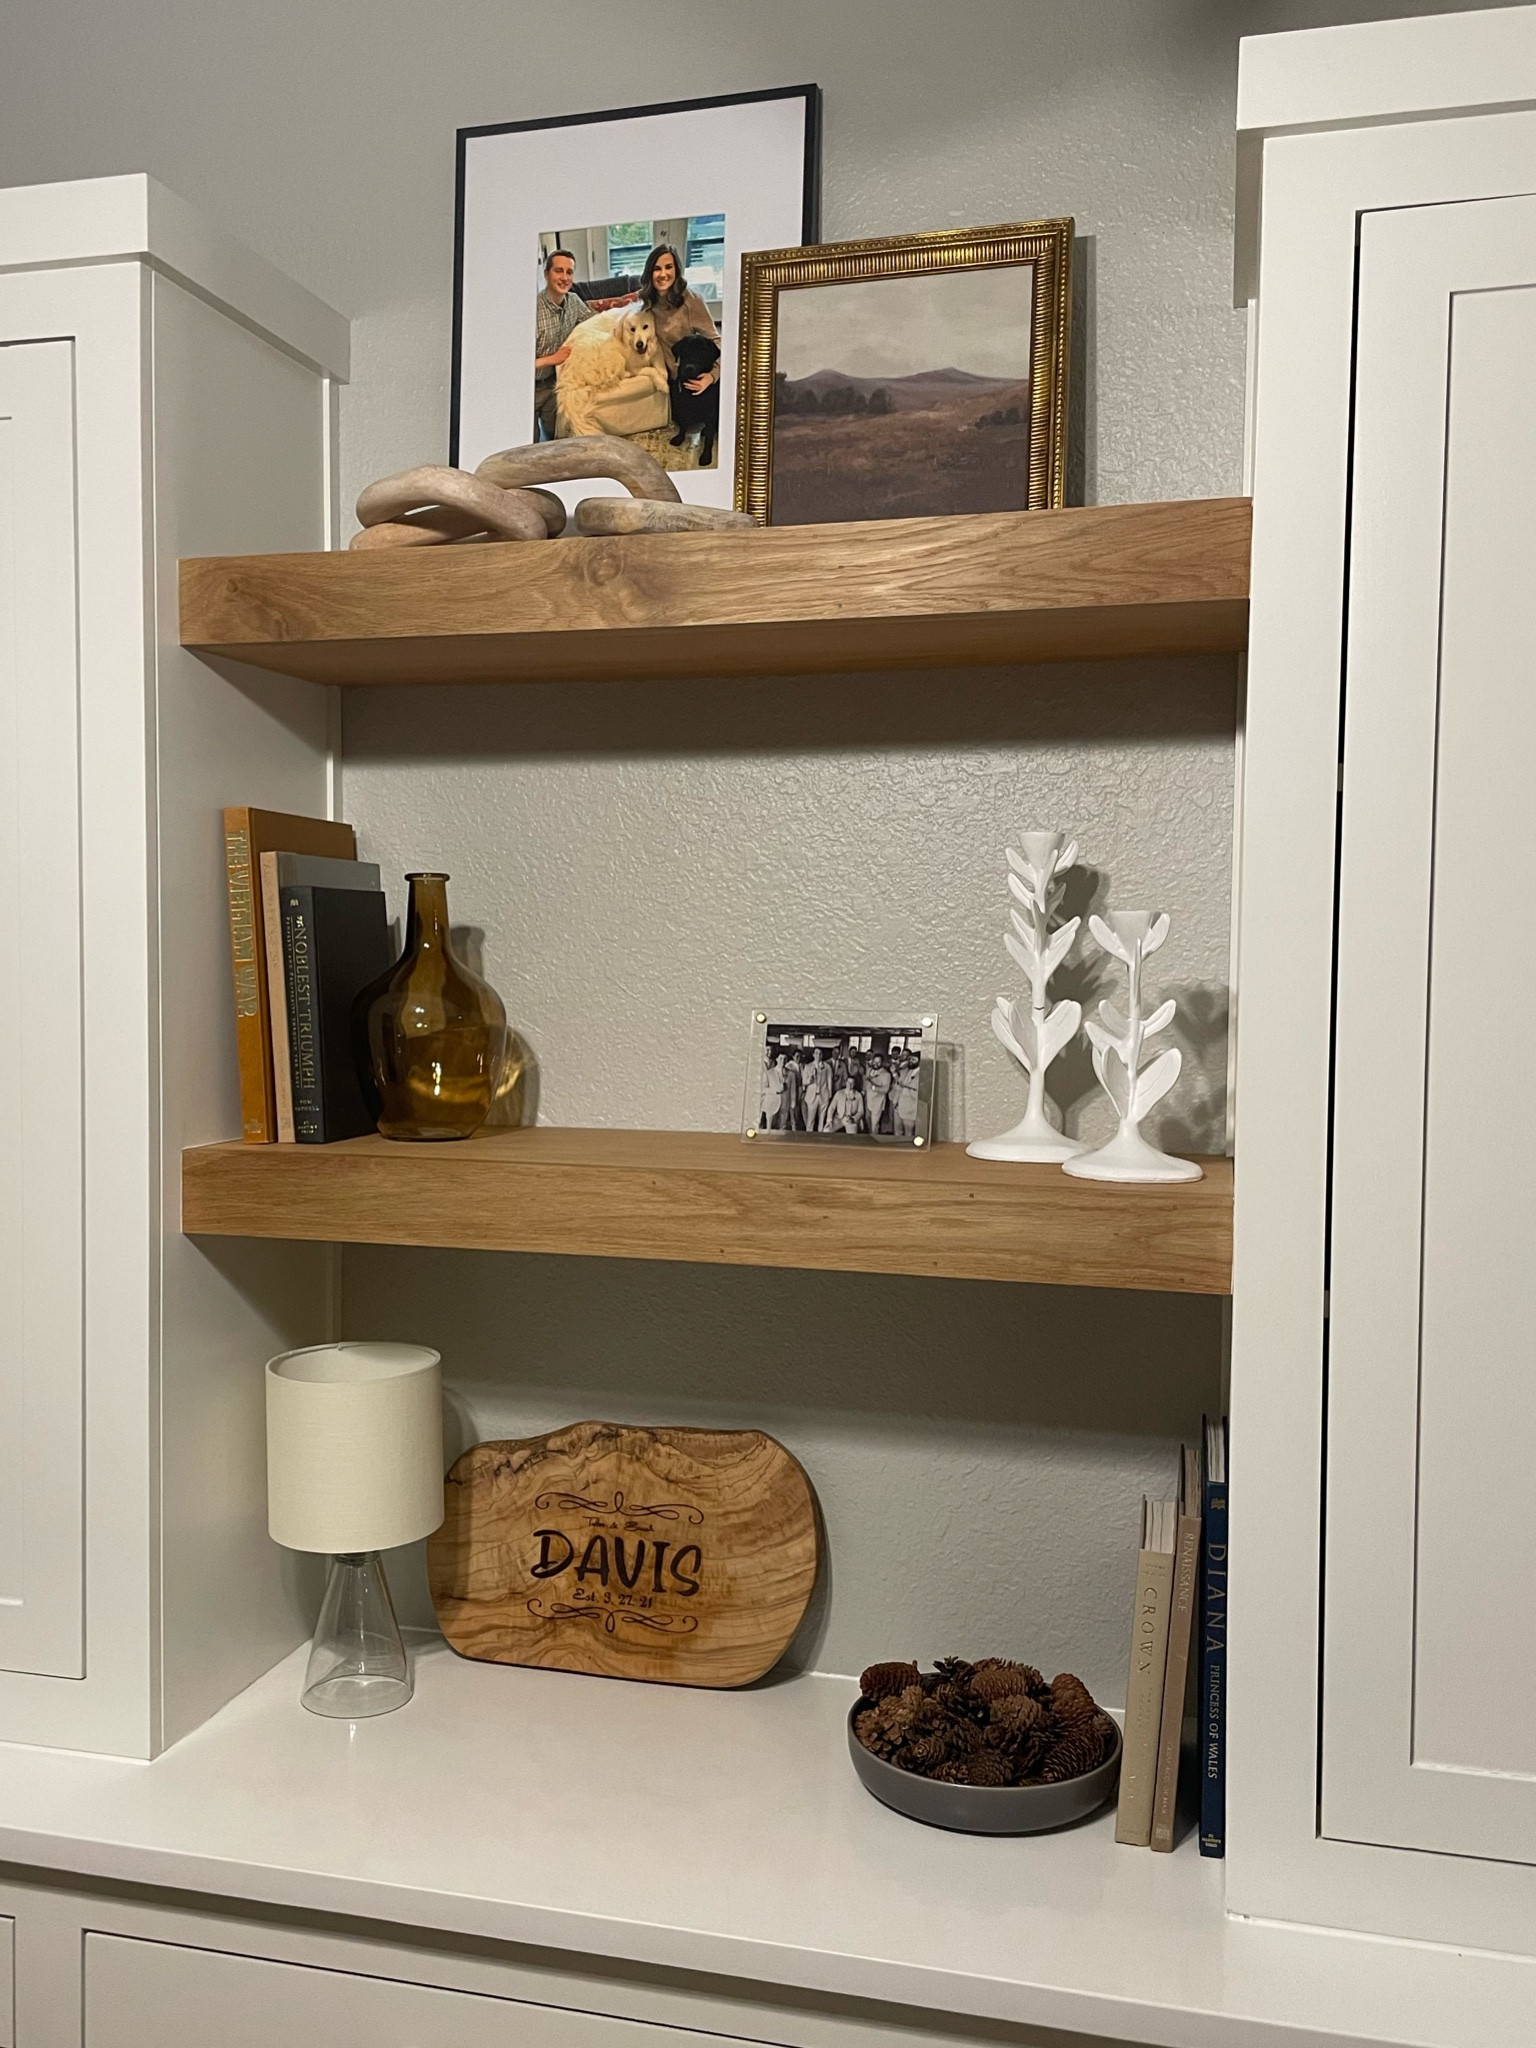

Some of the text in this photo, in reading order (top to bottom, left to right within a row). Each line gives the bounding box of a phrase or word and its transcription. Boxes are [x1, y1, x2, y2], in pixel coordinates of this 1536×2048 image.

[227, 830, 258, 1018] THE VIETNAM WAR
[294, 927, 311, 1005] NOBLEST
[299, 1009, 316, 1089] TRIUMPH
[530, 1529, 702, 1597] DAVIS
[572, 1587, 599, 1603] Est.
[639, 1596, 653, 1609] 21
[1177, 1532, 1195, 1612] RENAISSANCE
[1206, 1542, 1227, 1653] DIANA
[1138, 1586, 1158, 1675] CROWN
[1207, 1665, 1220, 1779] PRINCESS OF WALES
